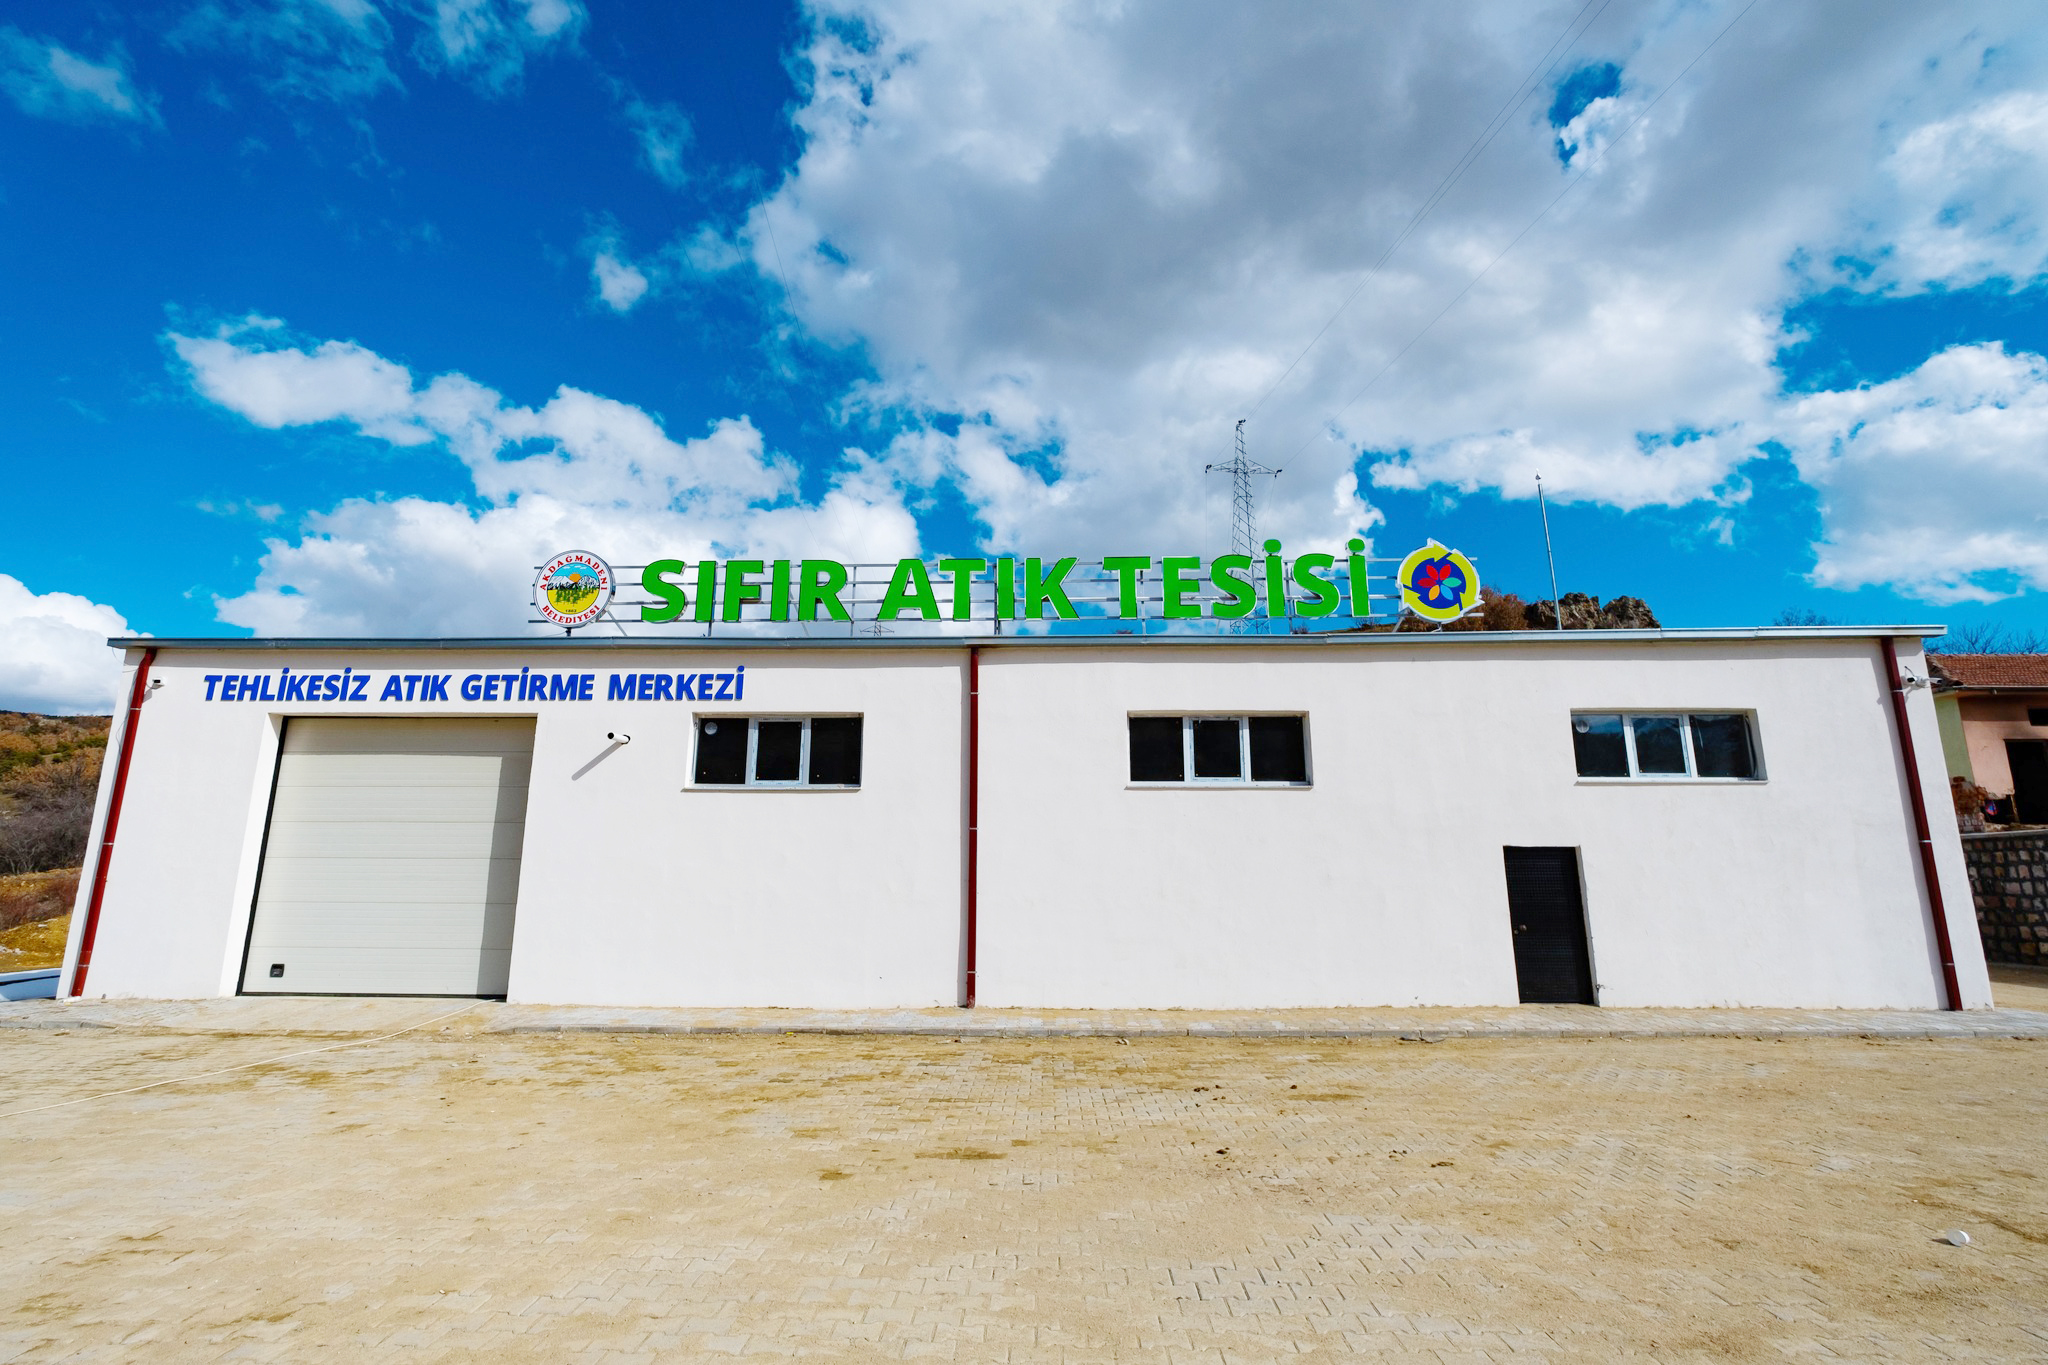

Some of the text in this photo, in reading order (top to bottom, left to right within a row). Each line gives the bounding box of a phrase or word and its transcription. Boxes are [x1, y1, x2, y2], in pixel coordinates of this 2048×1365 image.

[640, 538, 1370, 623] SIFIR ATIK TESİSİ
[203, 665, 745, 701] TEHLİKESİZ ATIK GETİRME MERKEZİ
